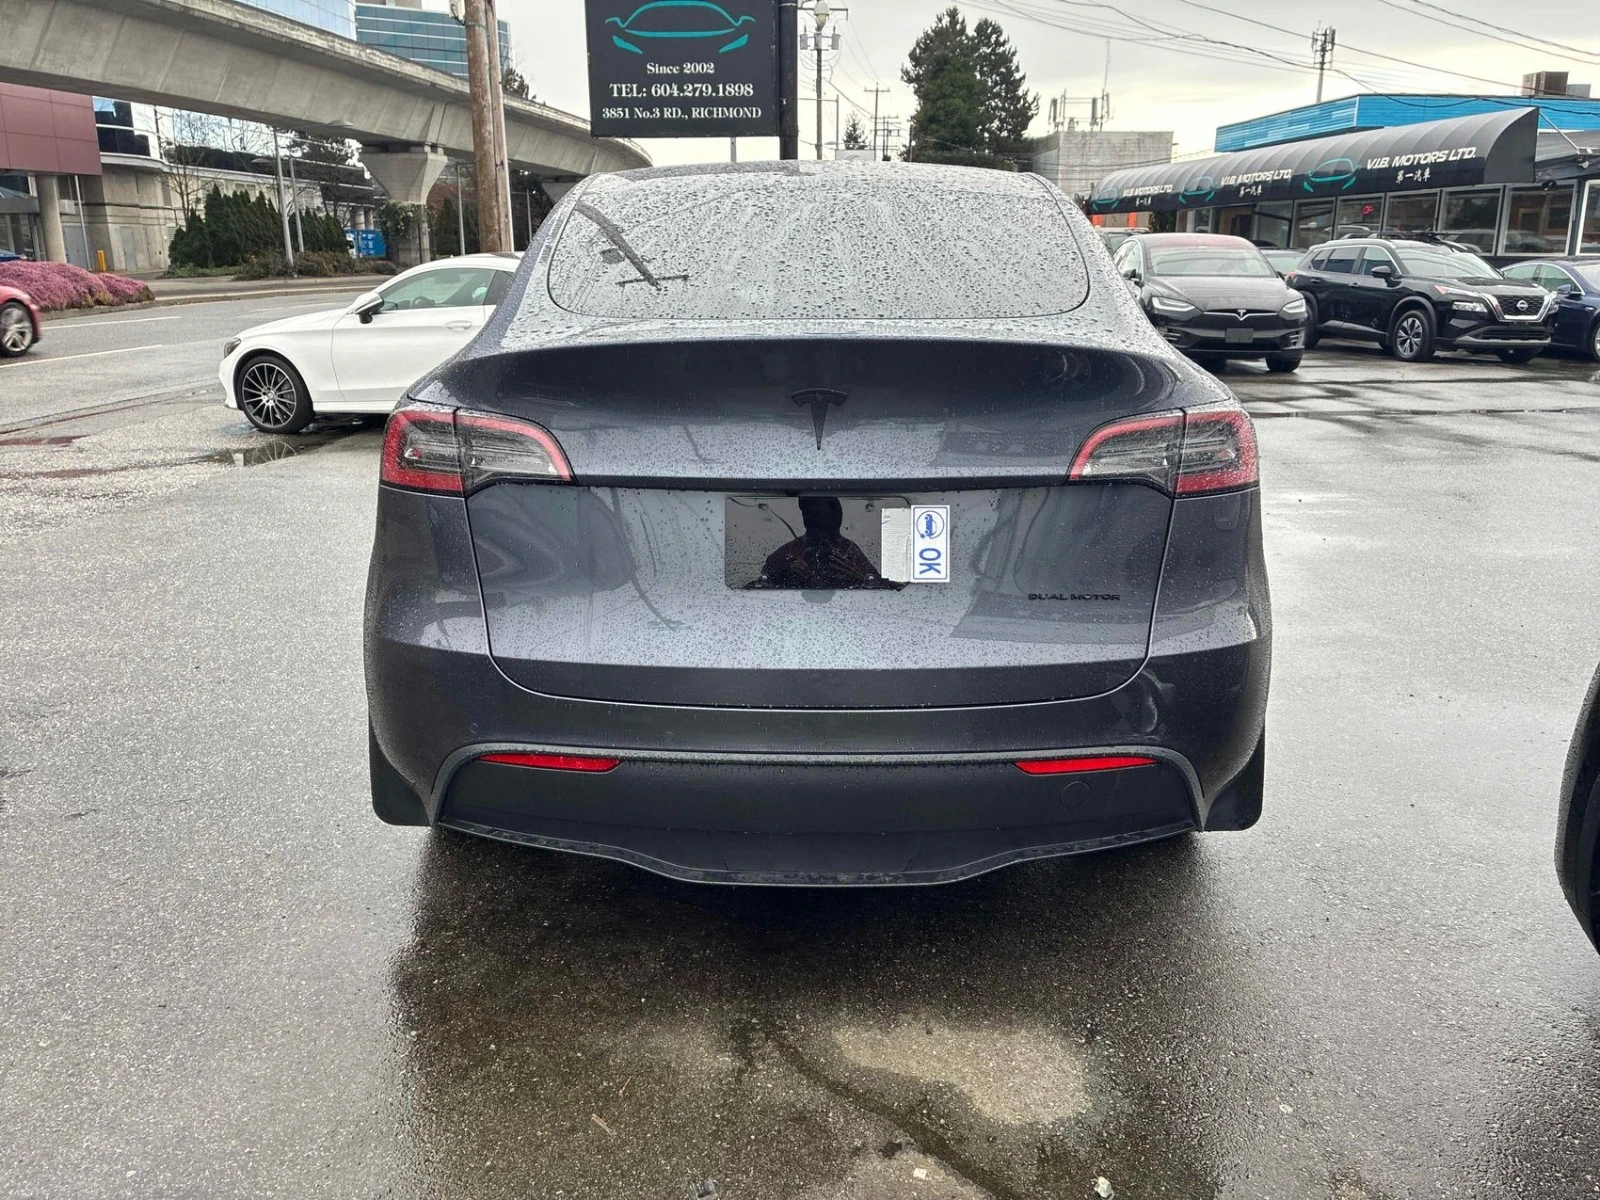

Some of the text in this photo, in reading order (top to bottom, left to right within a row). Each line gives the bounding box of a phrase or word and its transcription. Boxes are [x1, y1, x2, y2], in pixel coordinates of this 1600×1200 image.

[646, 62, 715, 74] Since 2002
[609, 83, 754, 98] TEL: 604.279.1898
[602, 107, 762, 120] 3851 No.3 RD., RICHMOND
[1392, 150, 1449, 168] MOTORS
[1448, 146, 1477, 161] LTD.
[1237, 170, 1274, 184] MOTORS
[919, 548, 941, 575] OK
